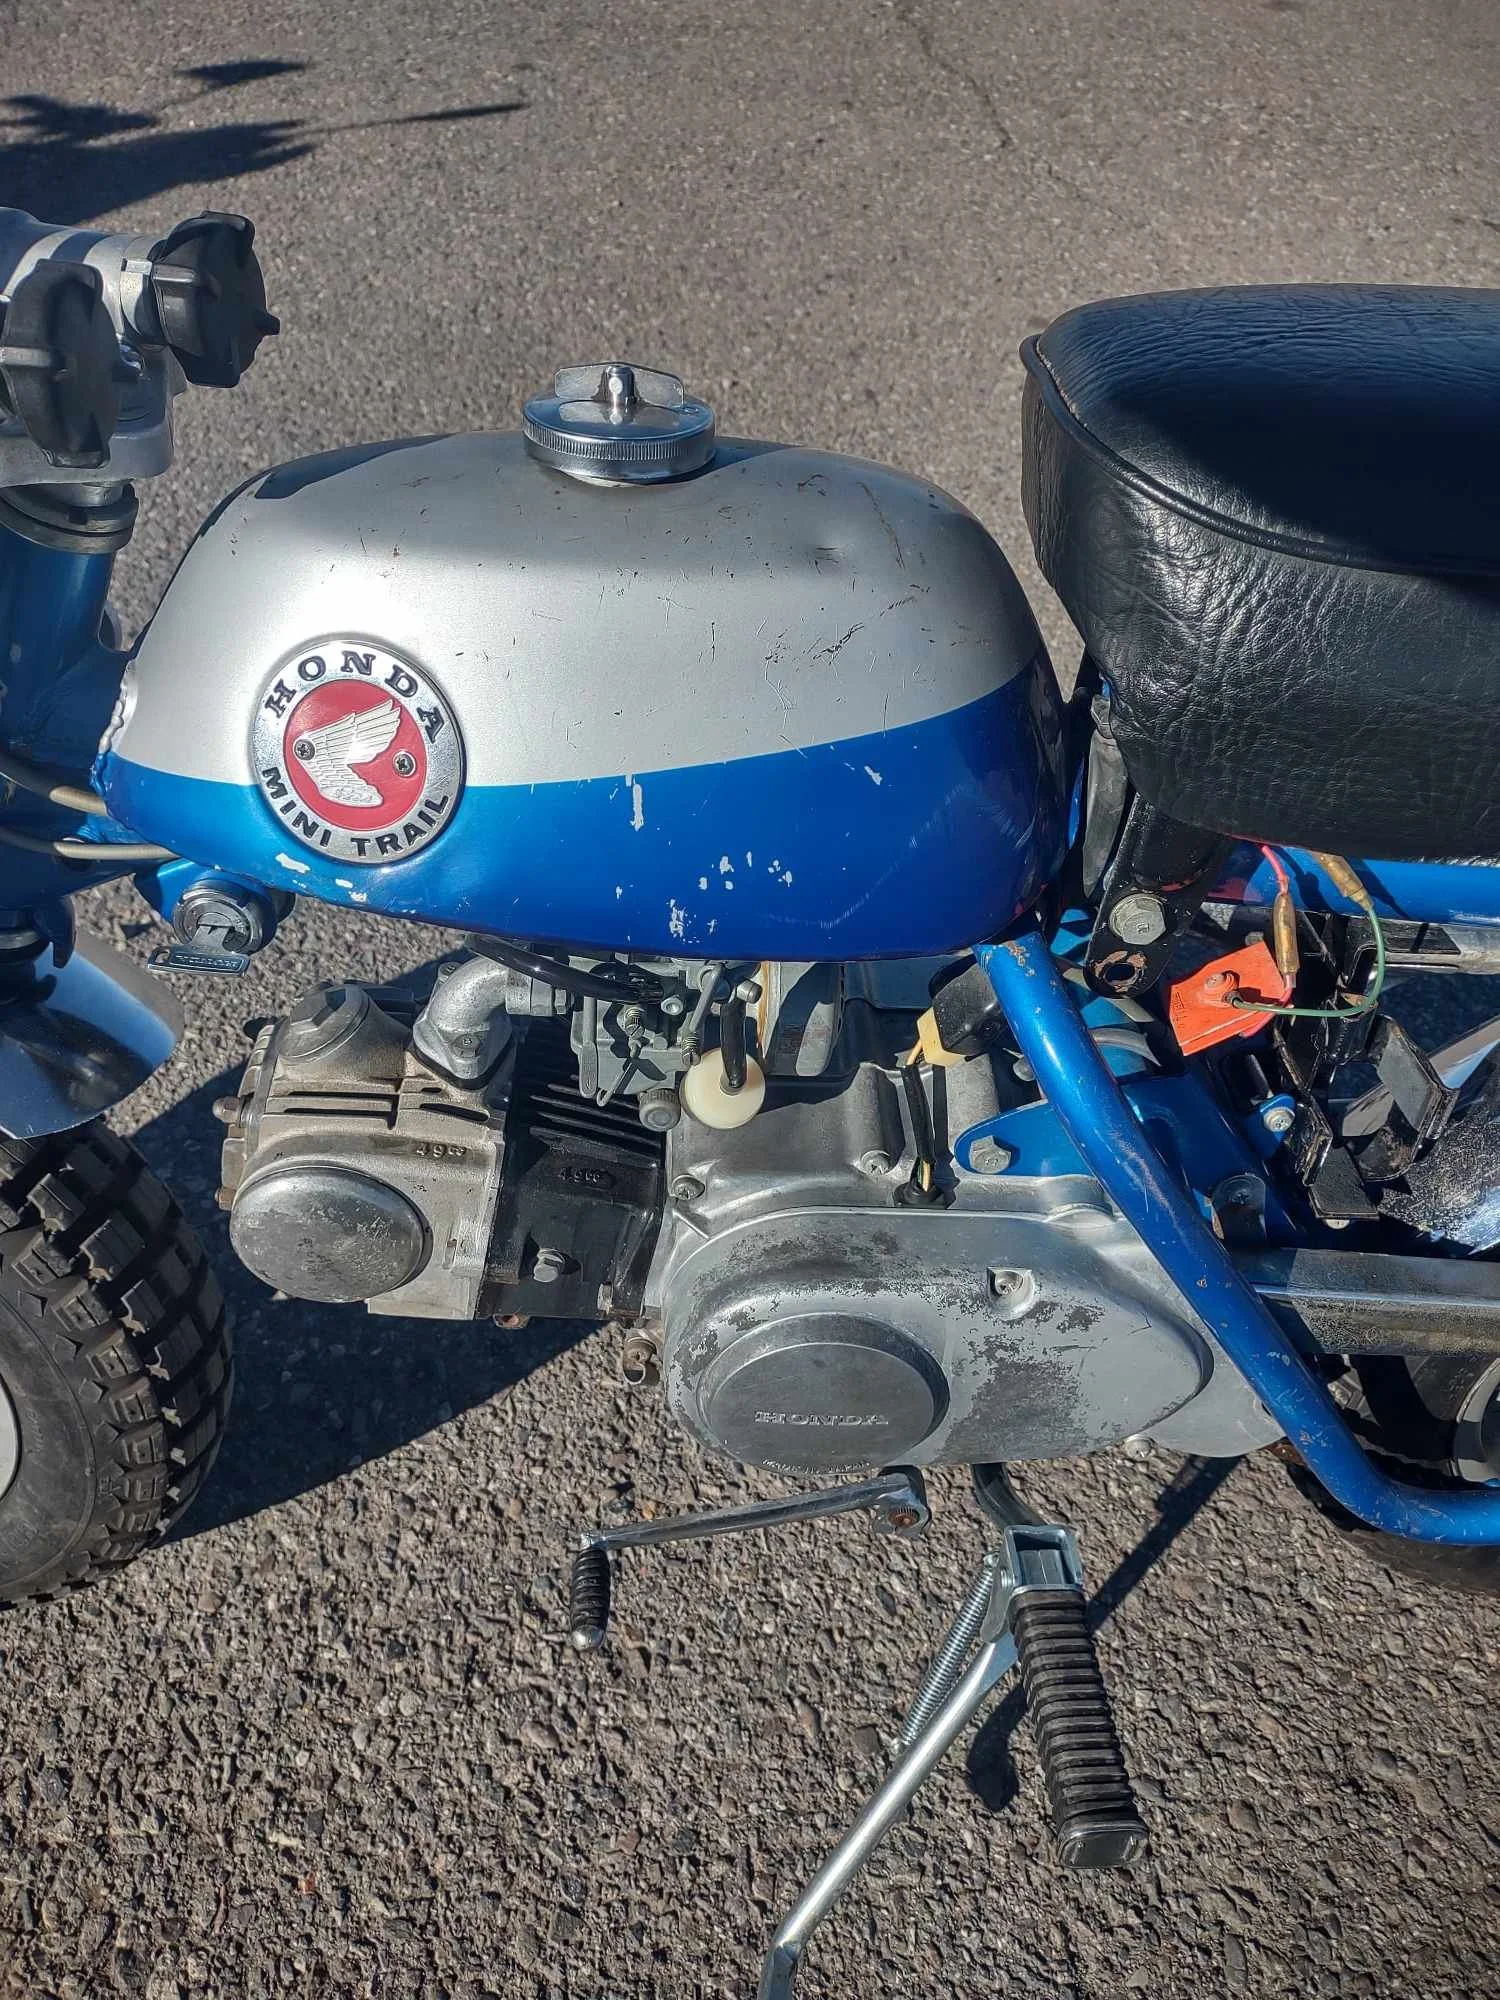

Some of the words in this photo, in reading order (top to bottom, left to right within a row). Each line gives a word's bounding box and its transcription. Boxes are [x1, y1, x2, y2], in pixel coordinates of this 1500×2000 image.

[264, 650, 445, 744] HONDA
[262, 766, 332, 847] MINI
[350, 795, 449, 857] TRAIL
[754, 1411, 889, 1427] HONDA
